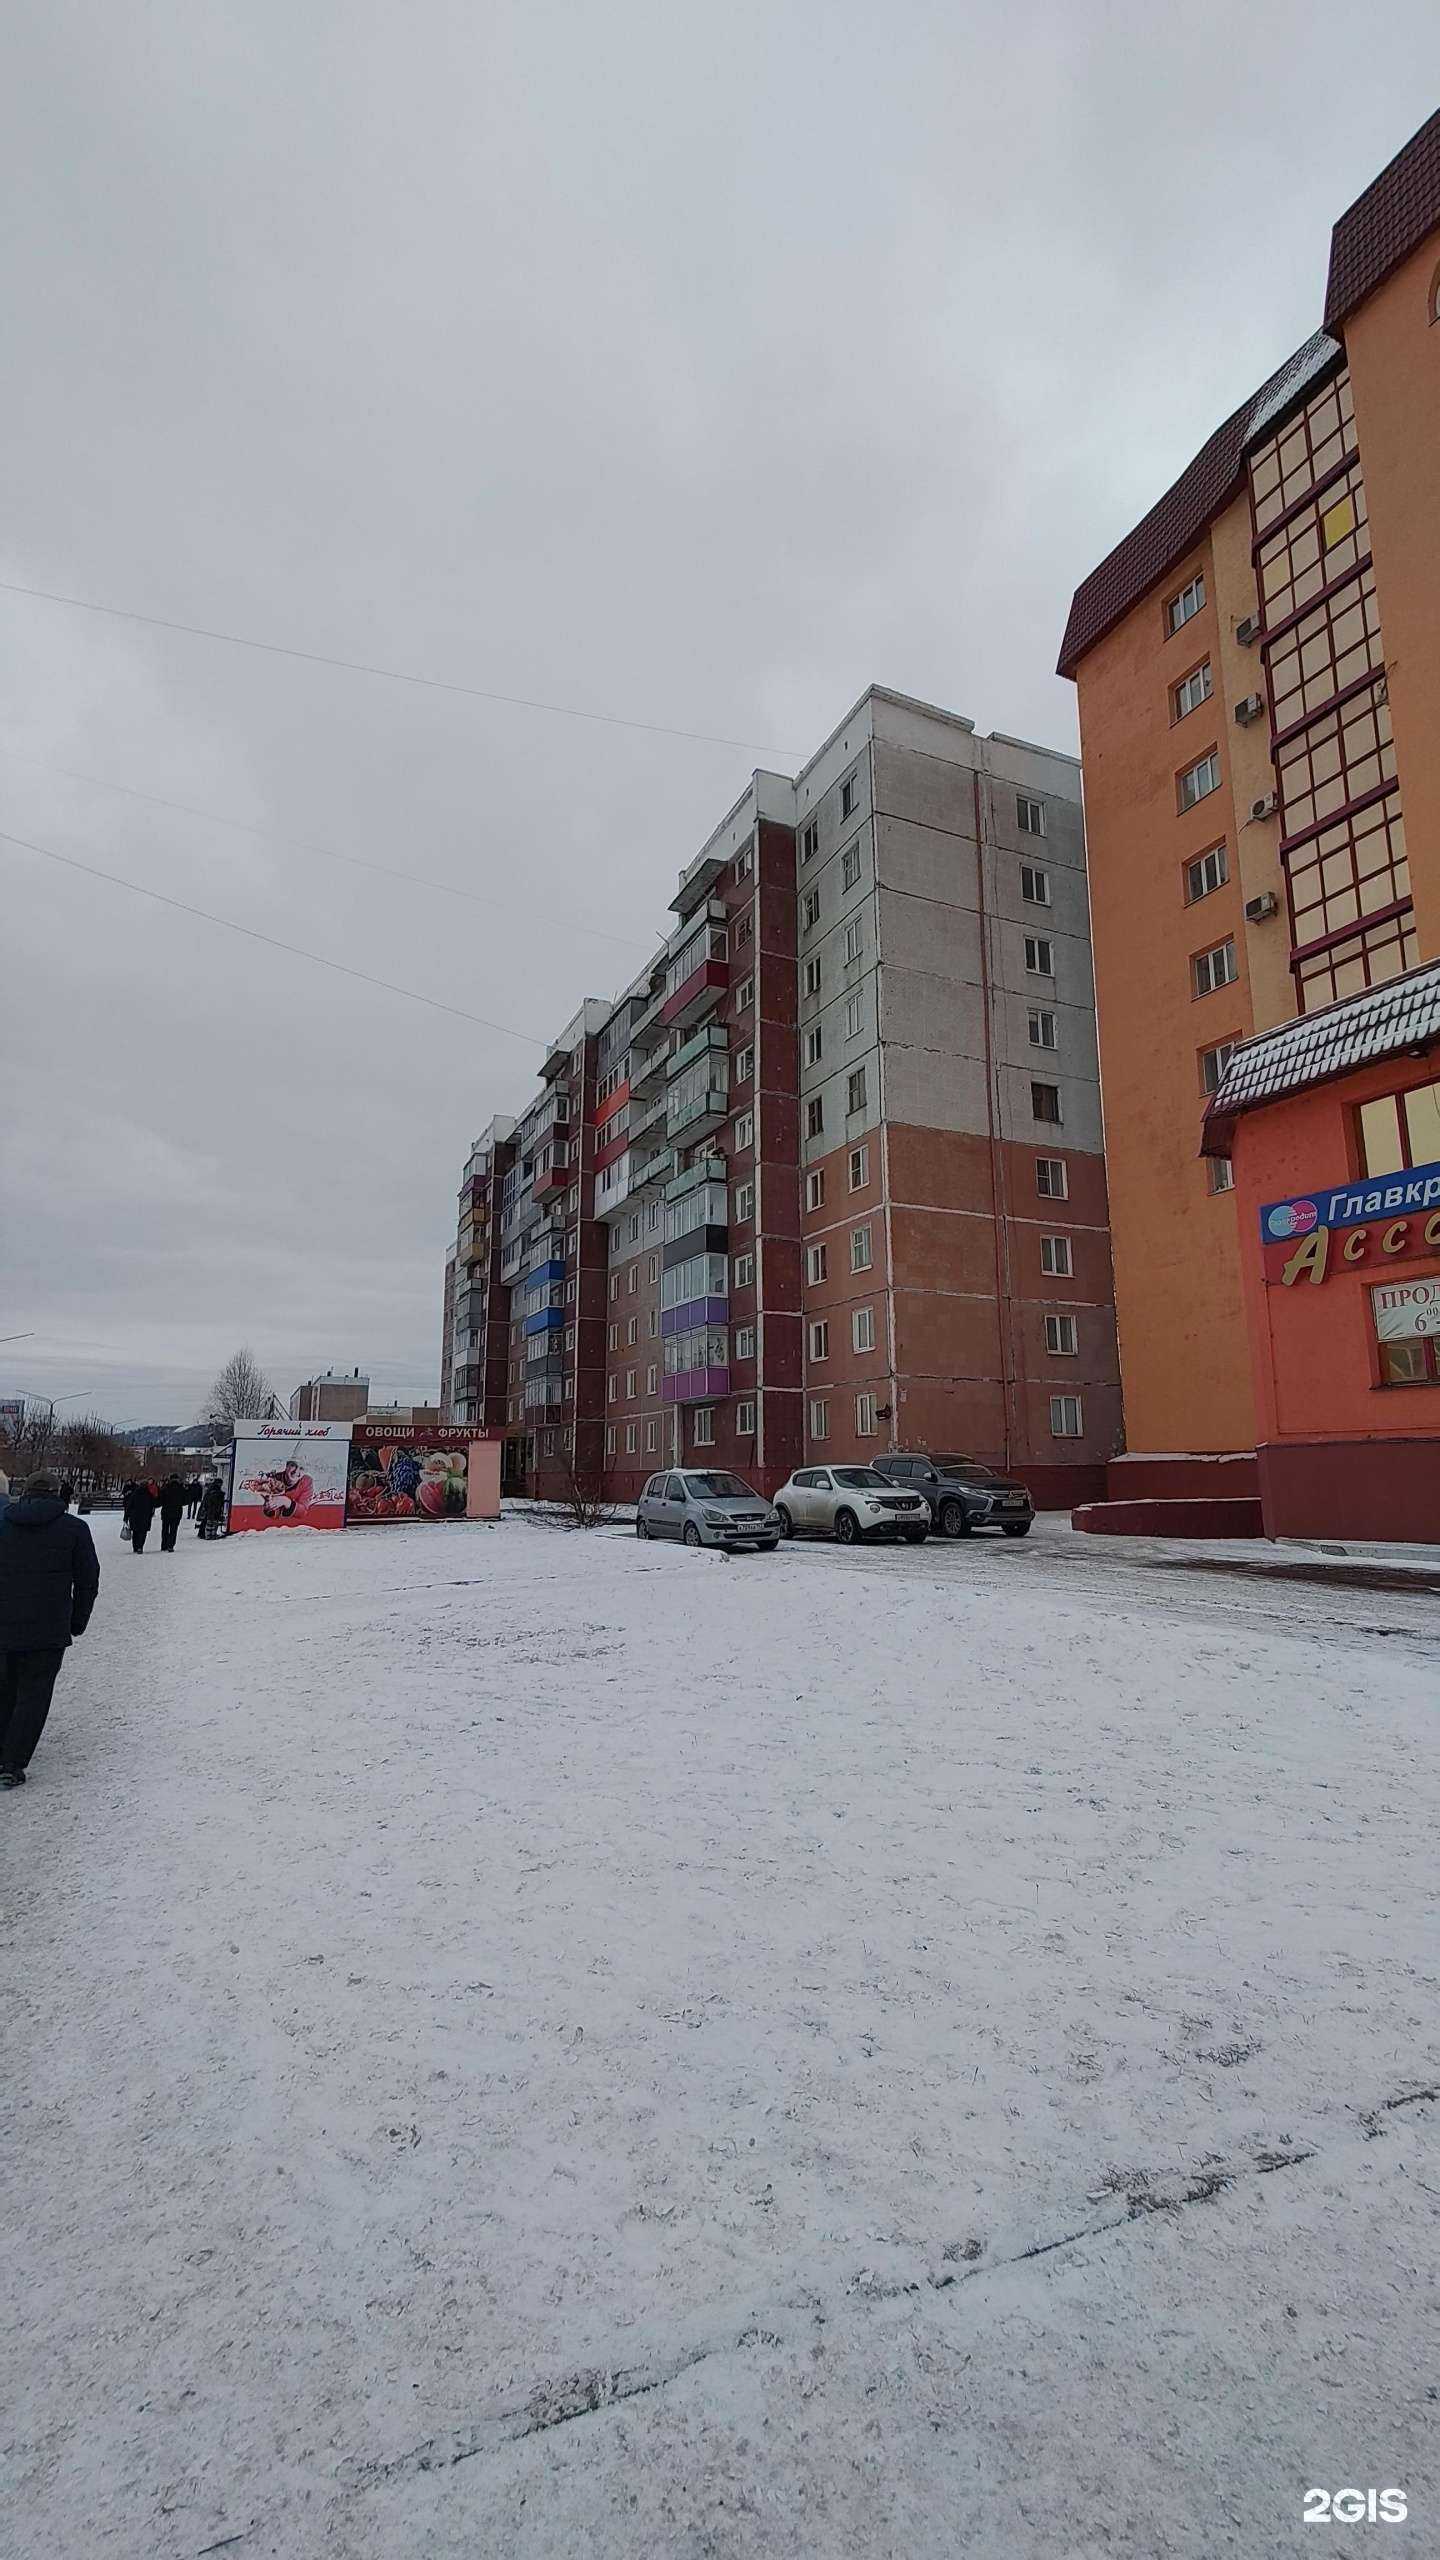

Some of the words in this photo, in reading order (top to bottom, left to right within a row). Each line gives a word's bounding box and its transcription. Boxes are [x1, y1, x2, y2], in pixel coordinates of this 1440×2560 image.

[257, 1422, 302, 1438] Горячий
[304, 1426, 331, 1437] хлеб
[365, 1426, 415, 1439] ОВОЩИ
[438, 1427, 489, 1438] ФРУКТЫ
